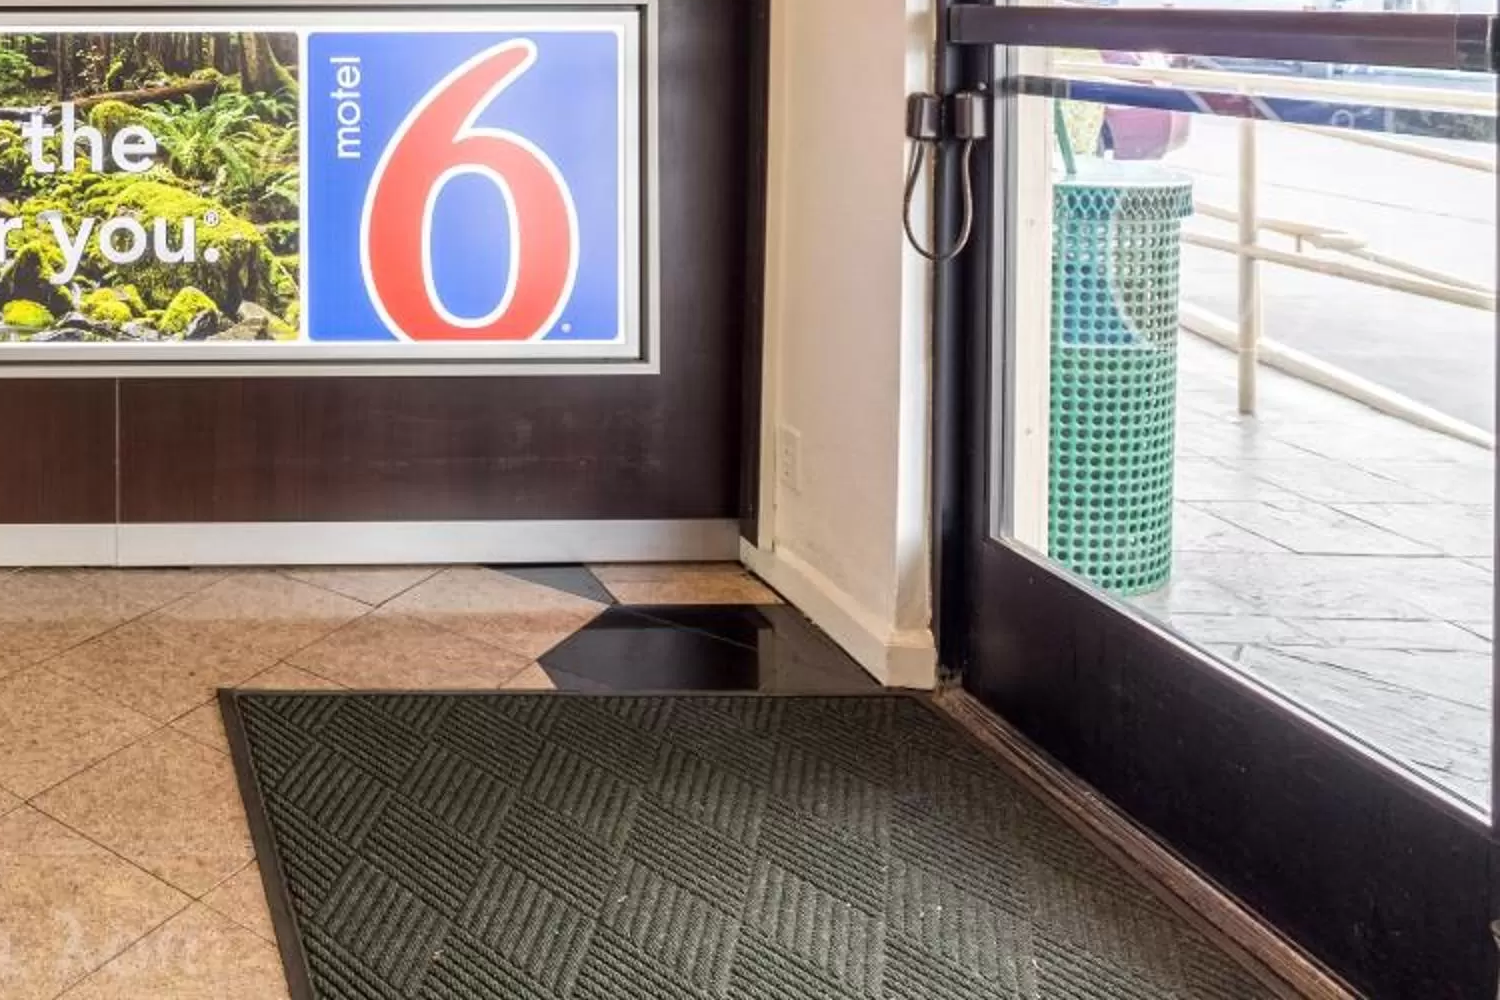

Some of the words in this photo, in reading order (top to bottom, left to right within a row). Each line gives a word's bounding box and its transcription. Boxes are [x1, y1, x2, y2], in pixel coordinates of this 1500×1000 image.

[22, 102, 157, 174] the
[329, 56, 361, 159] motel
[359, 37, 580, 342] 6
